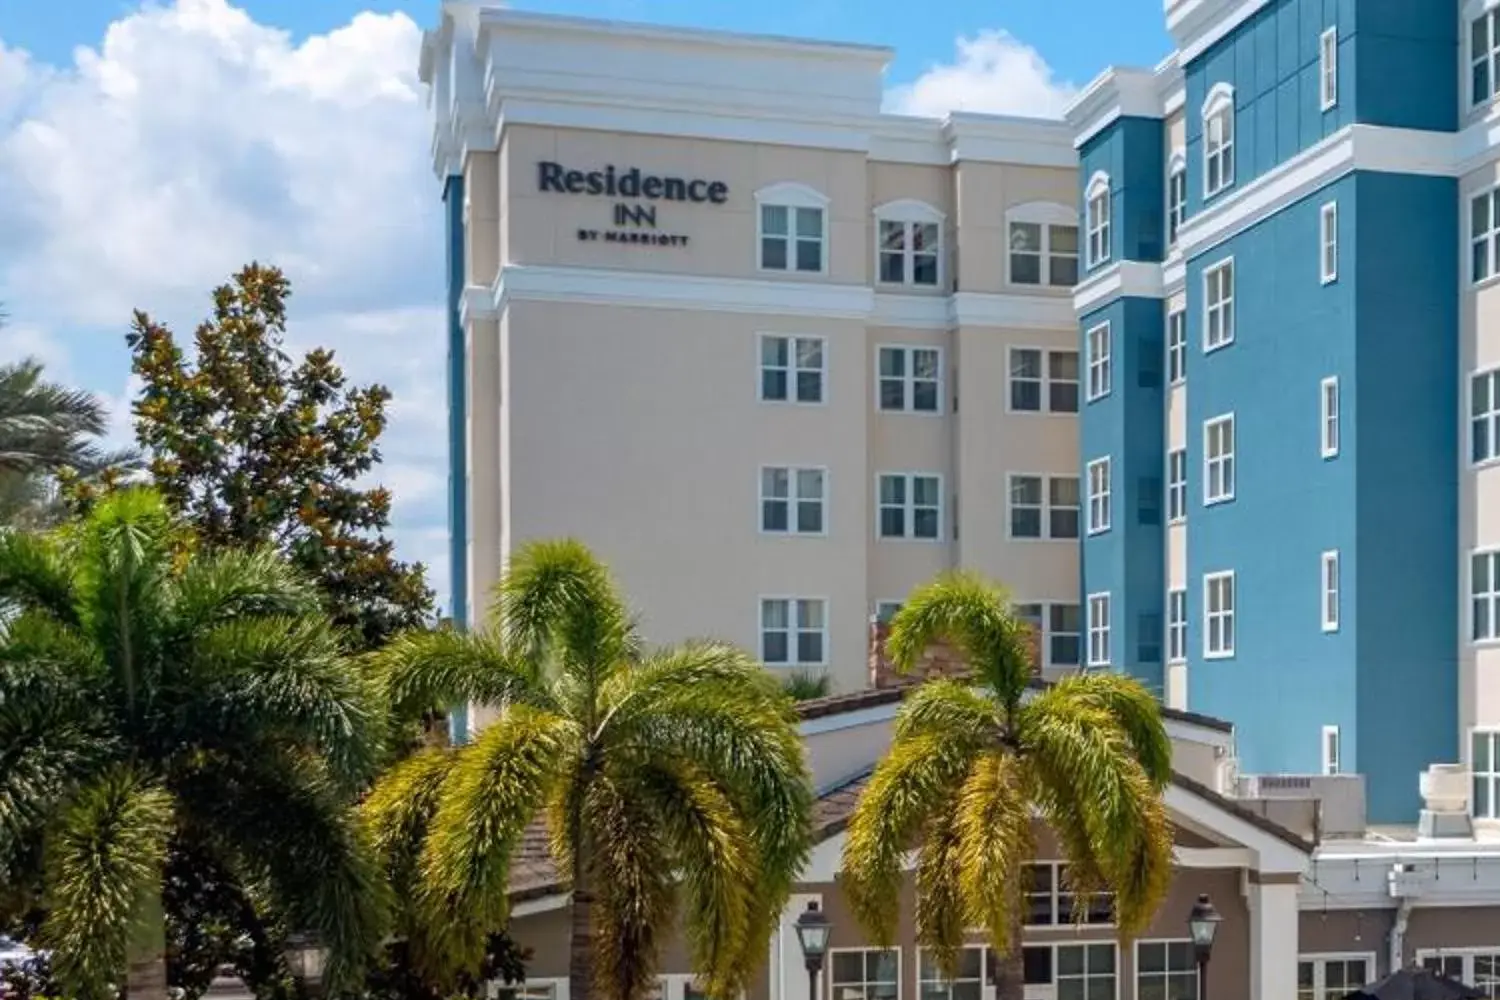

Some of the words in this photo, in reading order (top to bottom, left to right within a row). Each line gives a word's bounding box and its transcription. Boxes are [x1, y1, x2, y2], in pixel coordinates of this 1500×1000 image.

[538, 161, 728, 204] Residence
[614, 203, 657, 228] INN
[577, 229, 599, 241] BY
[604, 231, 689, 246] MARRIOTT
